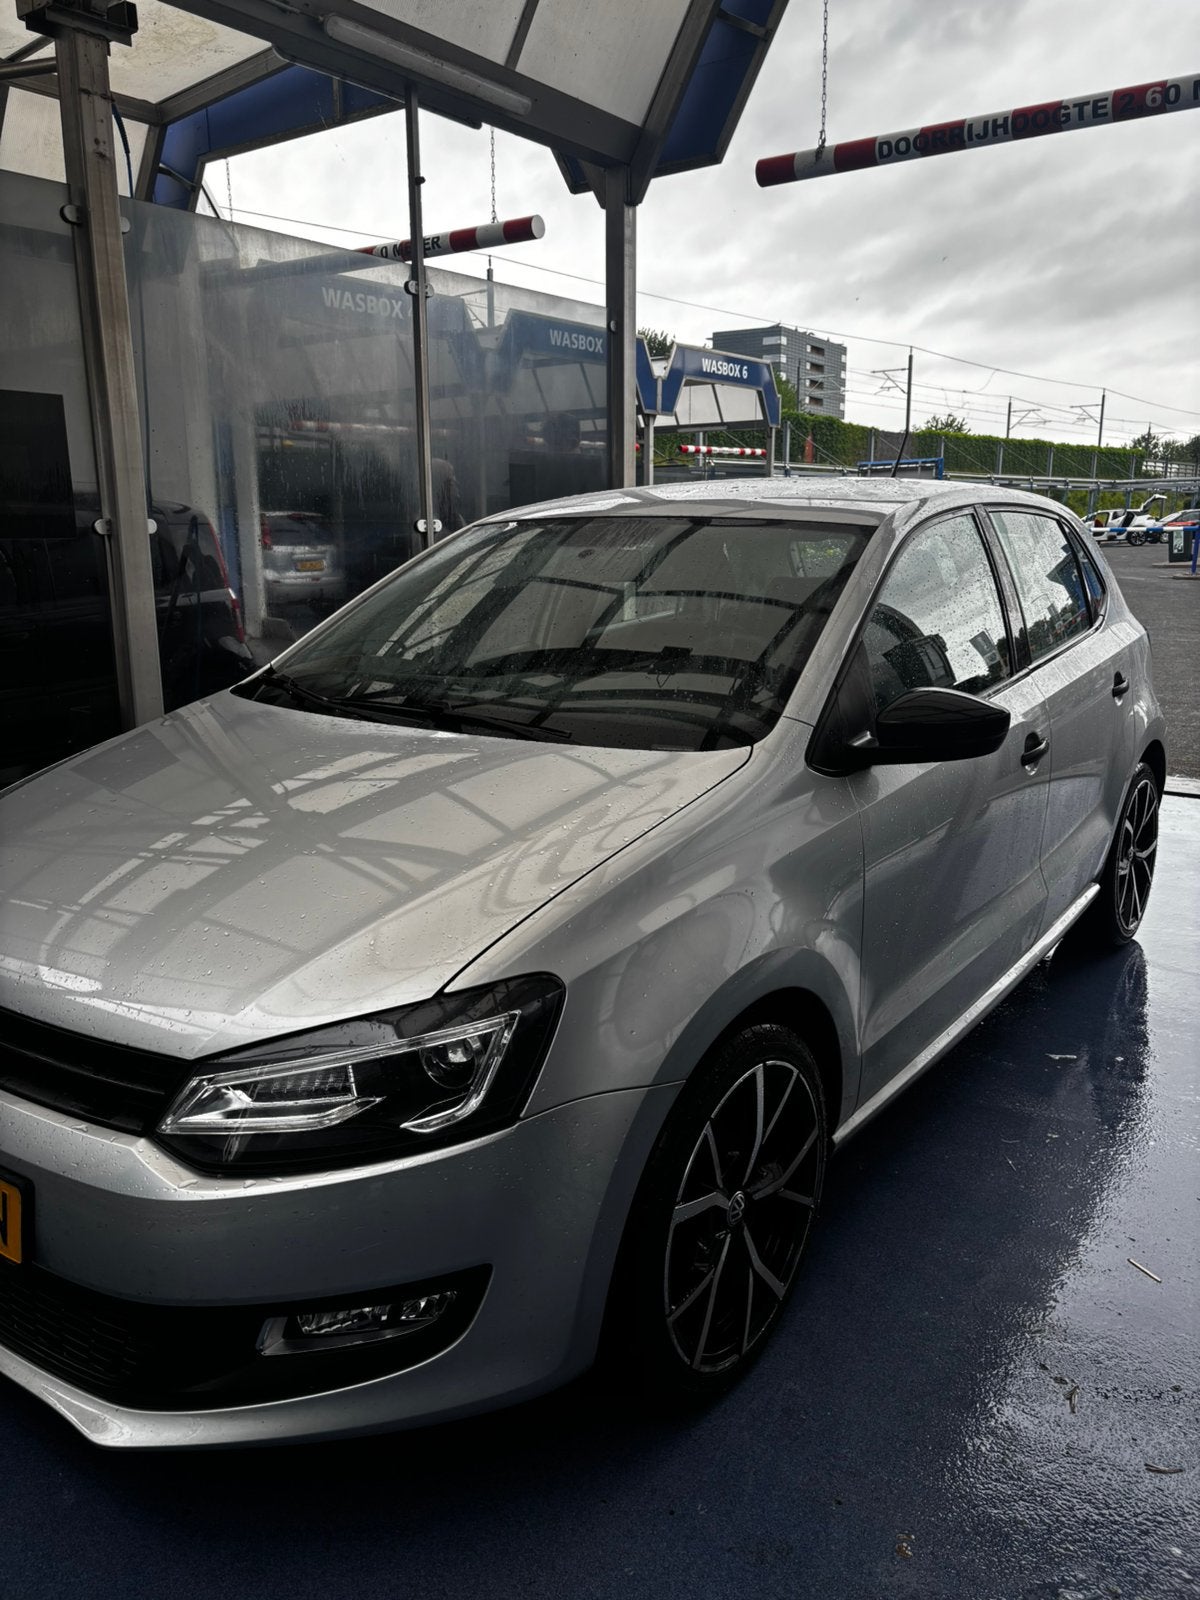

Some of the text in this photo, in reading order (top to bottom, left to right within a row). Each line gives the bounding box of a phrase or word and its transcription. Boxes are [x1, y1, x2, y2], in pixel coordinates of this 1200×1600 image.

[878, 97, 1109, 160] DOORRIJHOOGTE
[321, 286, 404, 319] WASBOX
[549, 328, 603, 354] WASBOX
[702, 358, 748, 379] WASBOX 6
